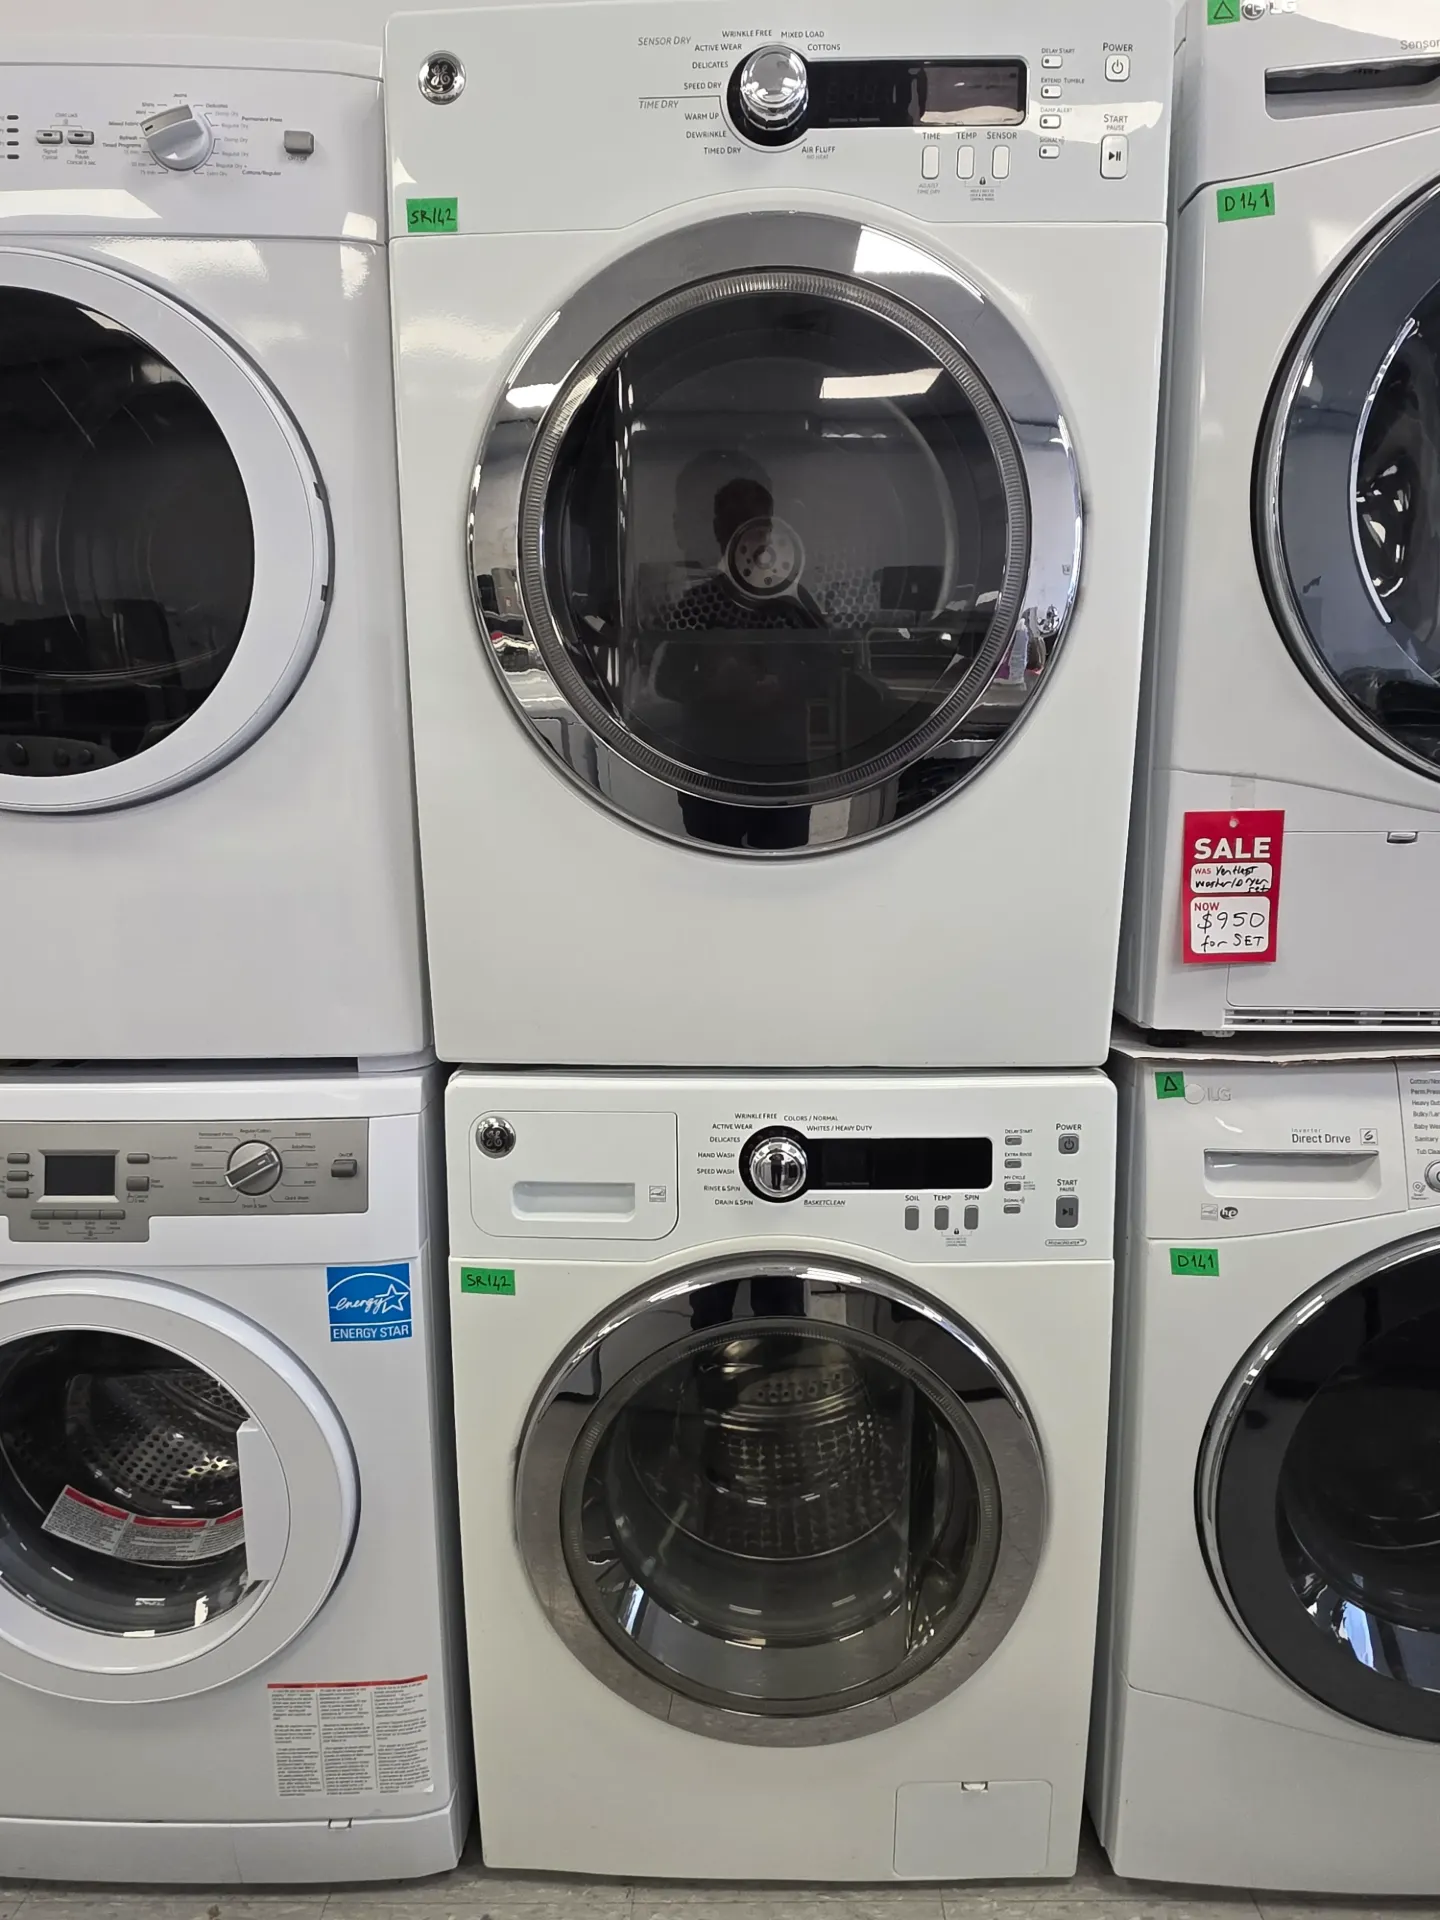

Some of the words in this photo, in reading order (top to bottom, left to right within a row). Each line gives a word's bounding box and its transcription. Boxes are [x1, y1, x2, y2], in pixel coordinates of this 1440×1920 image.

[722, 30, 754, 38] WRINKLE
[755, 29, 772, 37] FREE
[805, 30, 824, 38] LOAD
[638, 36, 672, 46] SENSOR
[673, 36, 691, 46] DRY
[694, 44, 719, 52] ACTIVE
[720, 43, 742, 51] WEAR
[807, 43, 841, 51] COTTONS
[1102, 42, 1133, 52] POWER
[692, 61, 729, 69] DELICATES
[684, 82, 706, 90] SPEED
[707, 82, 722, 90] DRY
[639, 100, 660, 109] TIME
[660, 100, 679, 109] DRY
[684, 113, 708, 121] WARM
[709, 112, 720, 120] UP
[1103, 114, 1128, 123] START
[686, 130, 727, 139] DEWRINKLE
[922, 132, 941, 140] TIME
[956, 131, 978, 140] TEMP
[986, 131, 1018, 140] SENSOR
[704, 146, 726, 155] TIMED
[727, 146, 742, 155] DRY
[801, 146, 814, 154] AIR
[815, 146, 836, 154] FLUFF
[1224, 188, 1270, 212] D141
[410, 207, 456, 226] SR142
[1193, 836, 1272, 860] SALE
[1194, 902, 1220, 912] NOW
[1197, 910, 1266, 934] $950
[1201, 934, 1228, 952] for
[1232, 933, 1265, 947] SET
[1056, 1123, 1082, 1132] POWER
[710, 1136, 741, 1144] DELICATES
[1292, 1134, 1323, 1144] Direct
[1325, 1134, 1352, 1144] Drive
[696, 1168, 716, 1176] SPEED
[1056, 1178, 1078, 1187] START
[905, 1194, 920, 1202] SOIL
[934, 1194, 952, 1202] TEMP
[1177, 1254, 1214, 1270] D141
[466, 1274, 512, 1292] SR142
[333, 1327, 378, 1340] ENERGY
[380, 1325, 409, 1338] STAR
